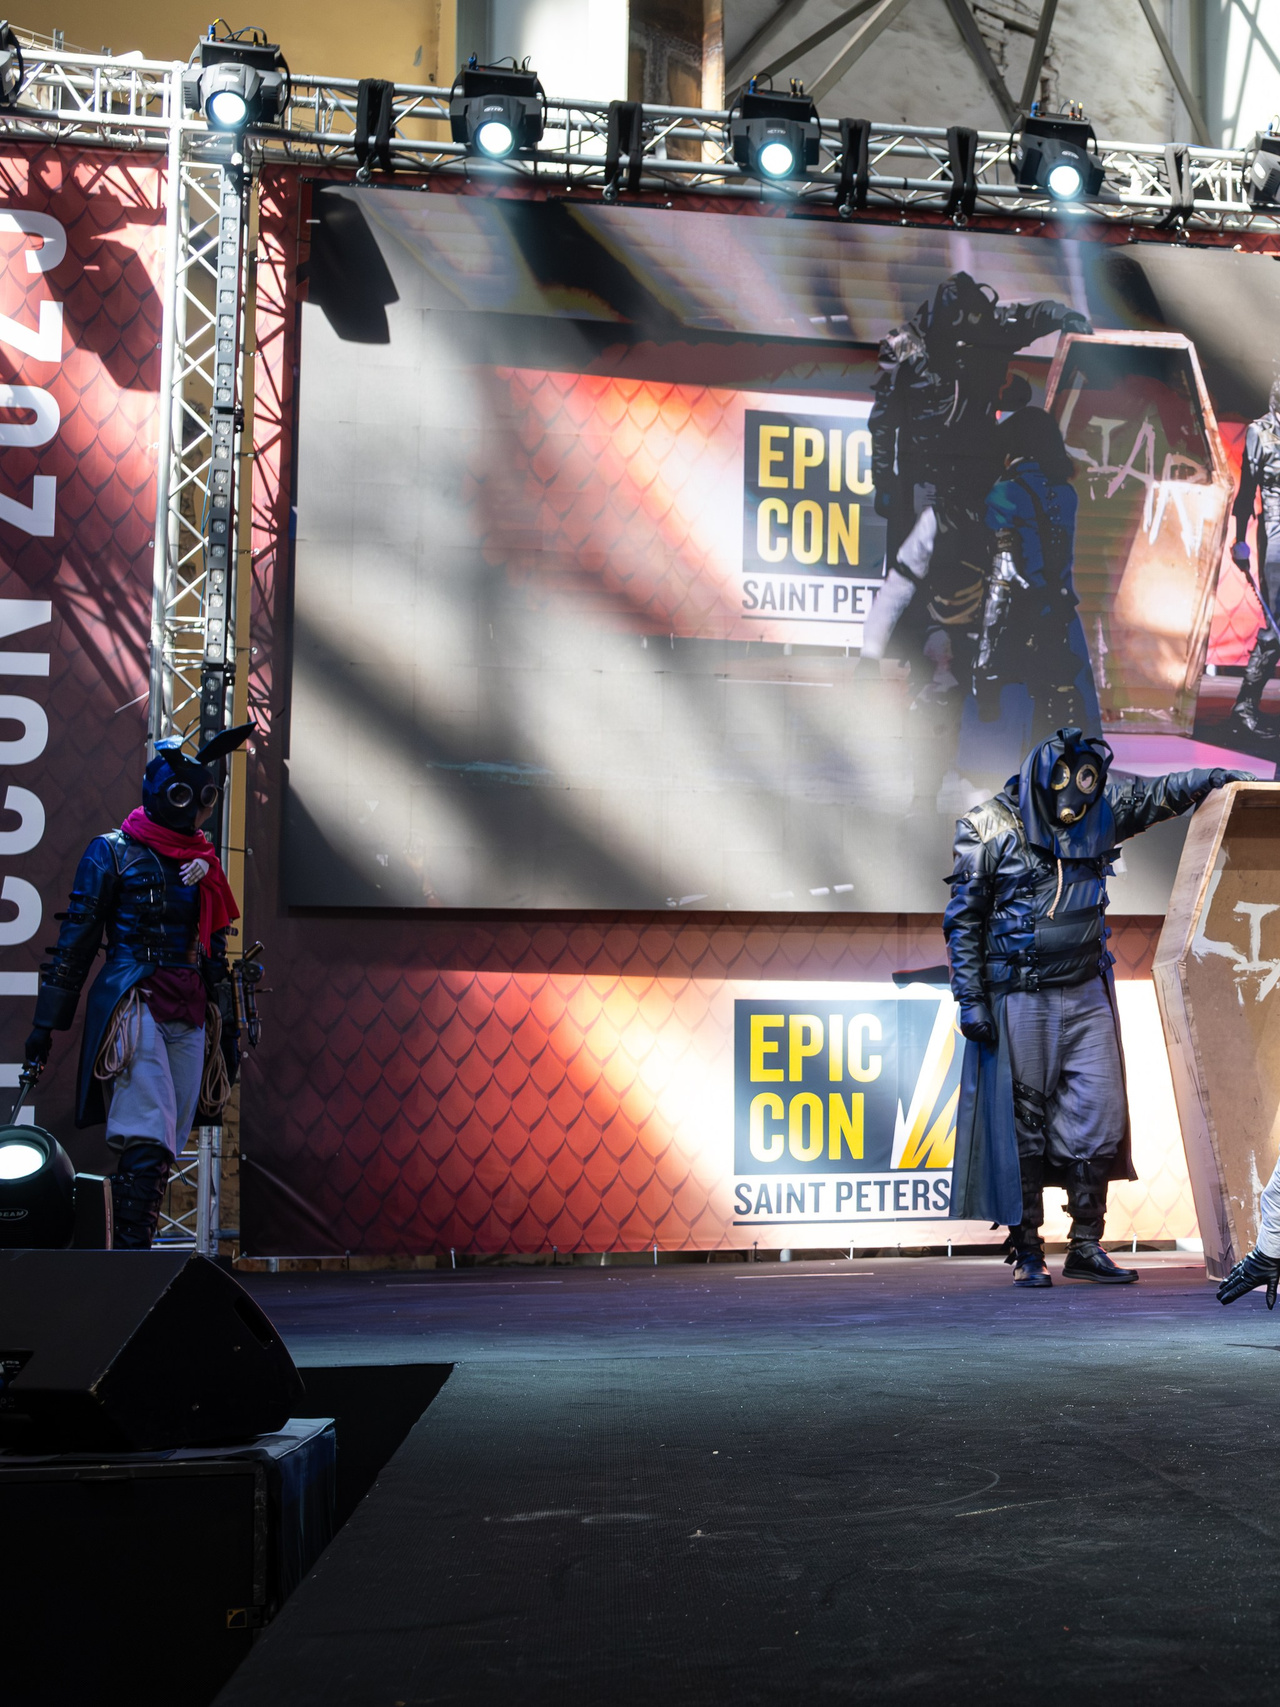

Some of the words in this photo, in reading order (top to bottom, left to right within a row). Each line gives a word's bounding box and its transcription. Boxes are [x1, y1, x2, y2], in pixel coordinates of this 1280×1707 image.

[758, 424, 875, 495] EPIC
[756, 497, 860, 566] CON
[742, 579, 824, 613] SAINT
[749, 1012, 883, 1083] EPIC
[749, 1092, 865, 1163] CON
[733, 1181, 826, 1216] SAINT
[835, 1178, 950, 1213] PETERS
